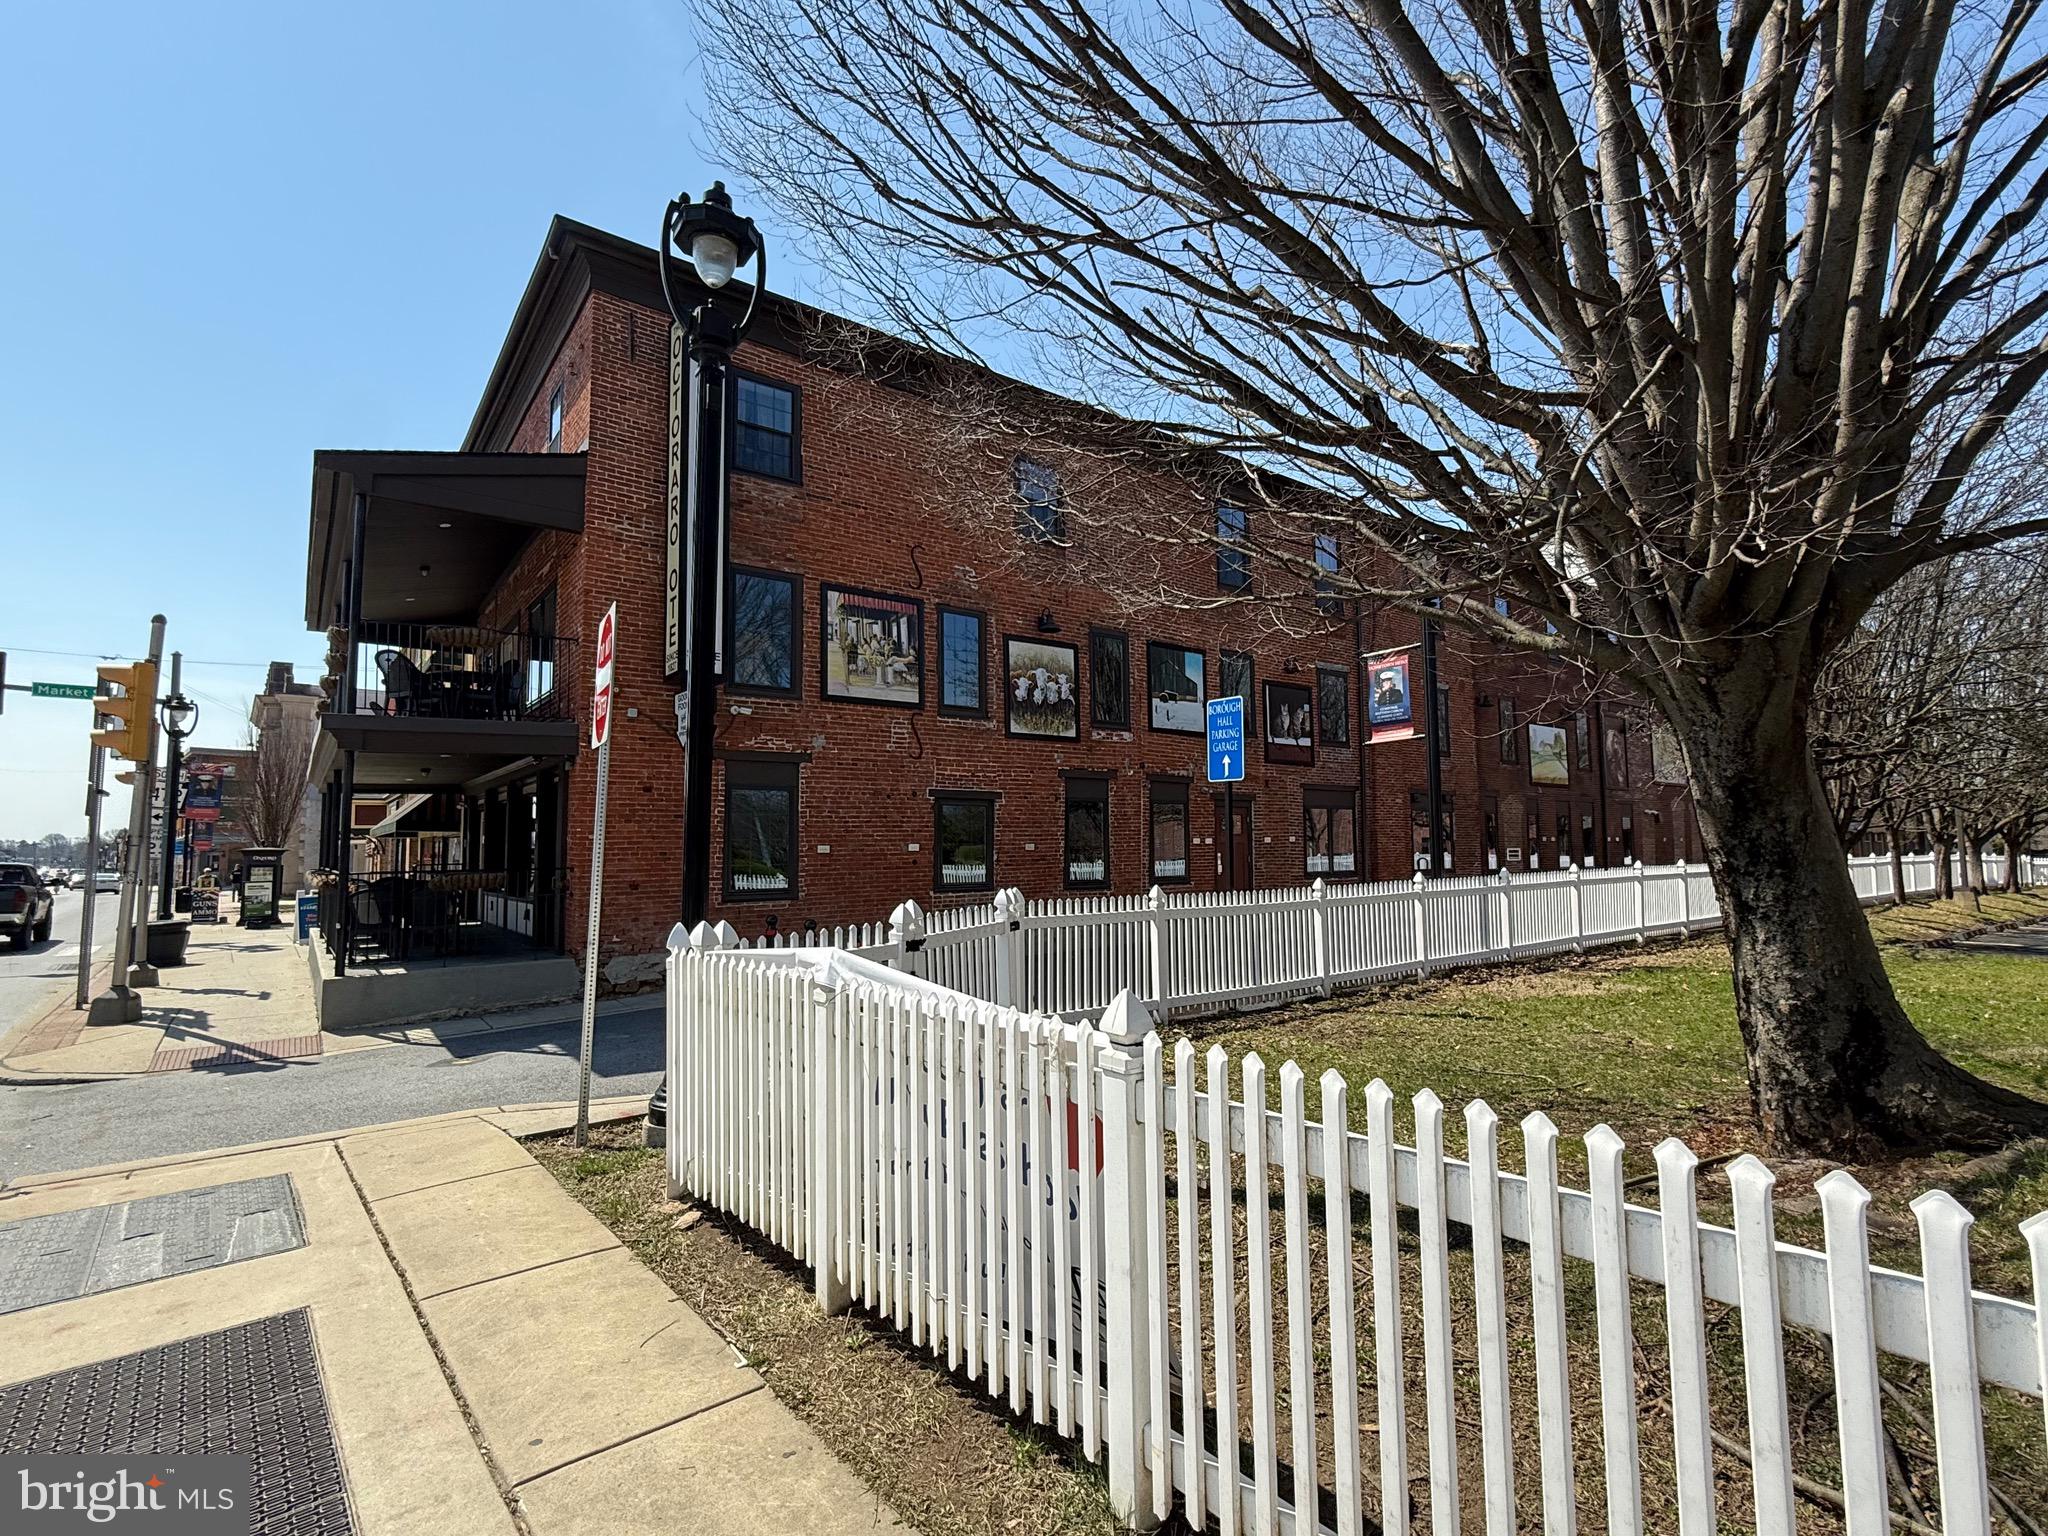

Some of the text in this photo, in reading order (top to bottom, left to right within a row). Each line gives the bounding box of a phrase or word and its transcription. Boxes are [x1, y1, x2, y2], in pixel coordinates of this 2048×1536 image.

[670, 336, 681, 546] OCTORARO
[38, 685, 88, 697] Market
[1209, 702, 1240, 715] BOROUGH
[1217, 716, 1232, 726] HALL
[1211, 728, 1239, 740] PARKING
[1212, 741, 1238, 752] GARAGE
